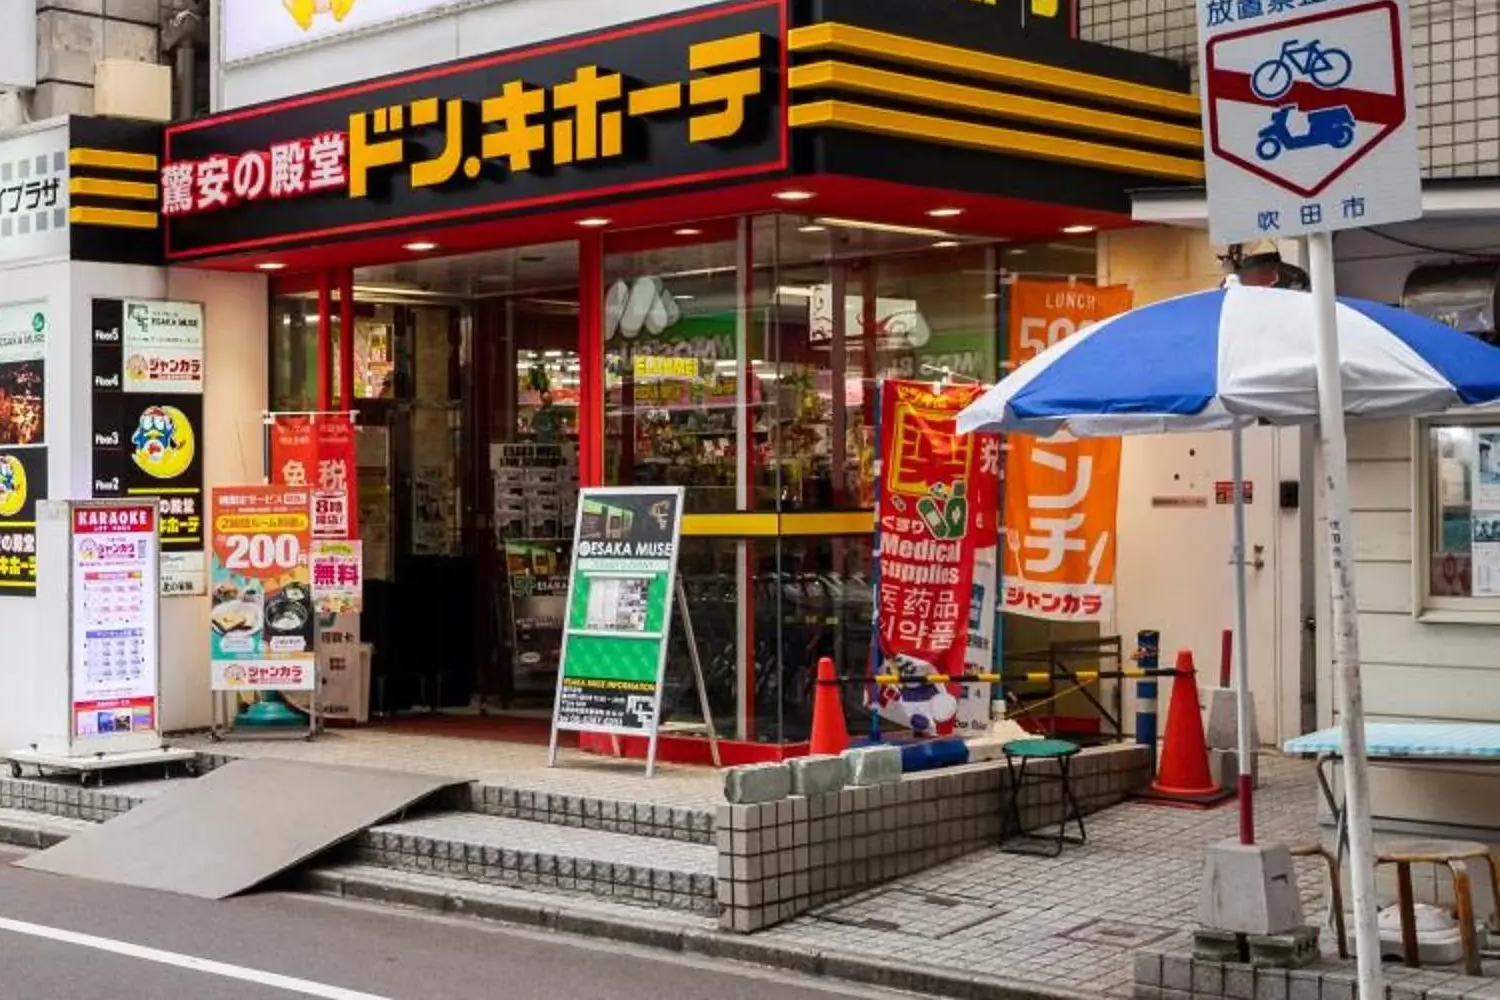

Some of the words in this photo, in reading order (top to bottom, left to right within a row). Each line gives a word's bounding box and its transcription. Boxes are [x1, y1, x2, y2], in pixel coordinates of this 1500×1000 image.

[160, 132, 347, 215] 驚安の殿堂
[1258, 197, 1365, 230] 吹田市
[1045, 292, 1096, 311] LUNCH
[150, 359, 200, 373] ジャンカラ
[78, 511, 147, 525] KARAOKE
[592, 541, 632, 556] ESAKA
[636, 541, 673, 557] MUSE
[880, 532, 961, 561] Medical
[314, 563, 358, 585] 無料
[1006, 586, 1102, 614] ジャンカラ
[248, 666, 302, 678] ジャンカラ
